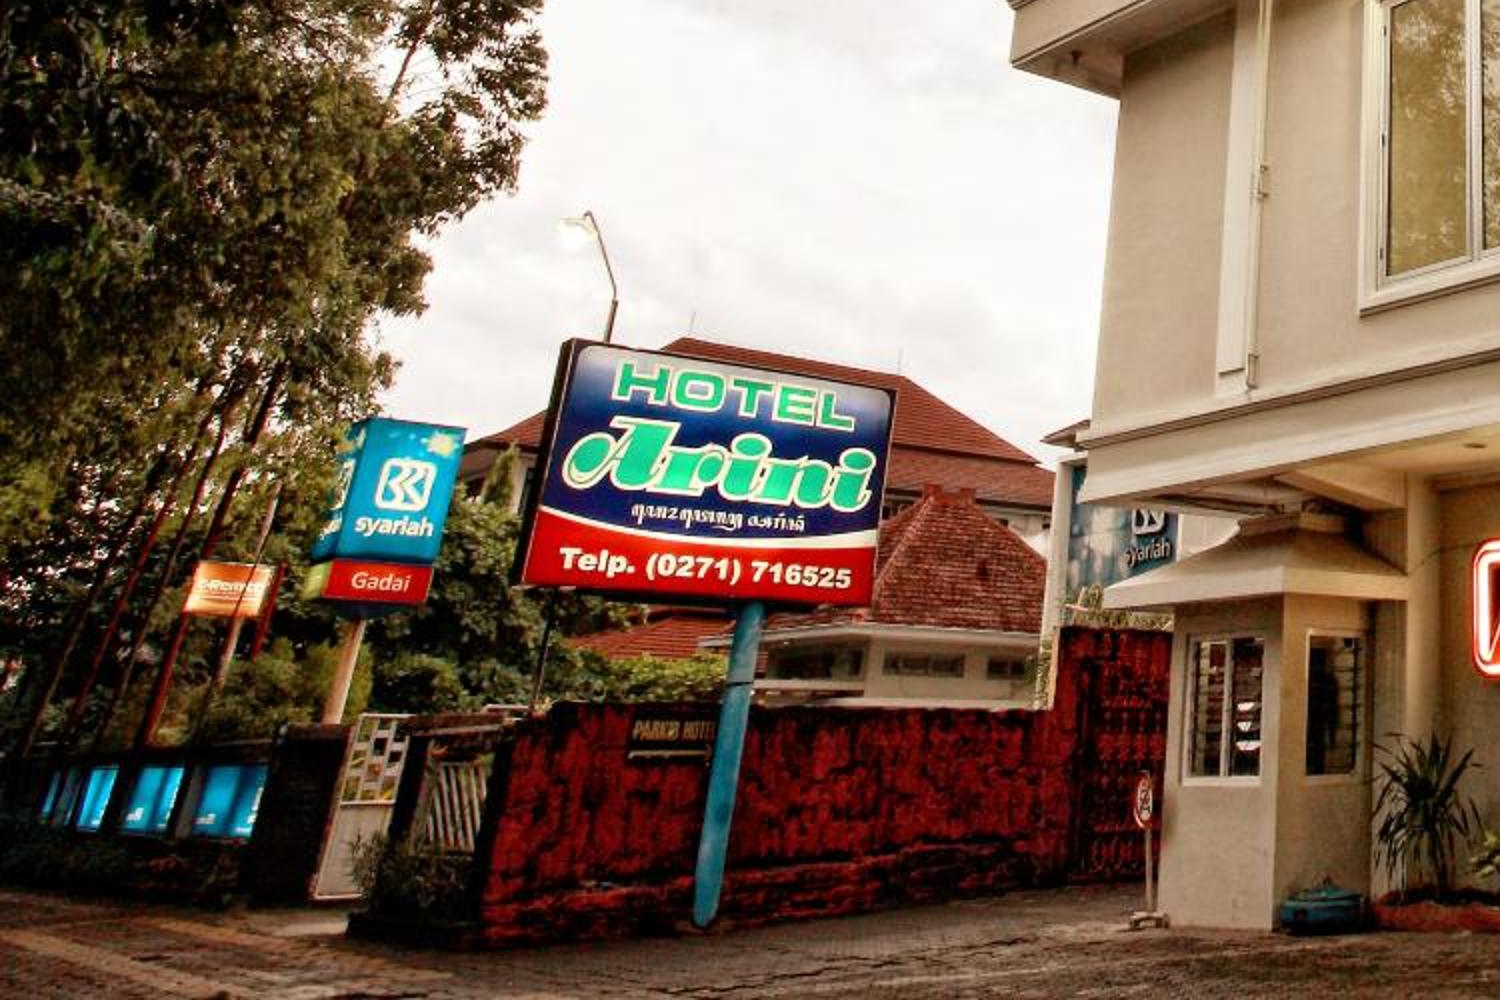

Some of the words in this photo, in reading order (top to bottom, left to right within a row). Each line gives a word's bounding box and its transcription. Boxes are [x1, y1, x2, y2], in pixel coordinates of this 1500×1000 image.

[611, 359, 856, 432] HOTEL
[561, 416, 877, 514] Arini
[354, 515, 434, 538] syariah
[351, 571, 411, 593] Gadai
[559, 546, 635, 577] Telp.
[645, 551, 741, 585] (0271)
[751, 561, 852, 589] 716525
